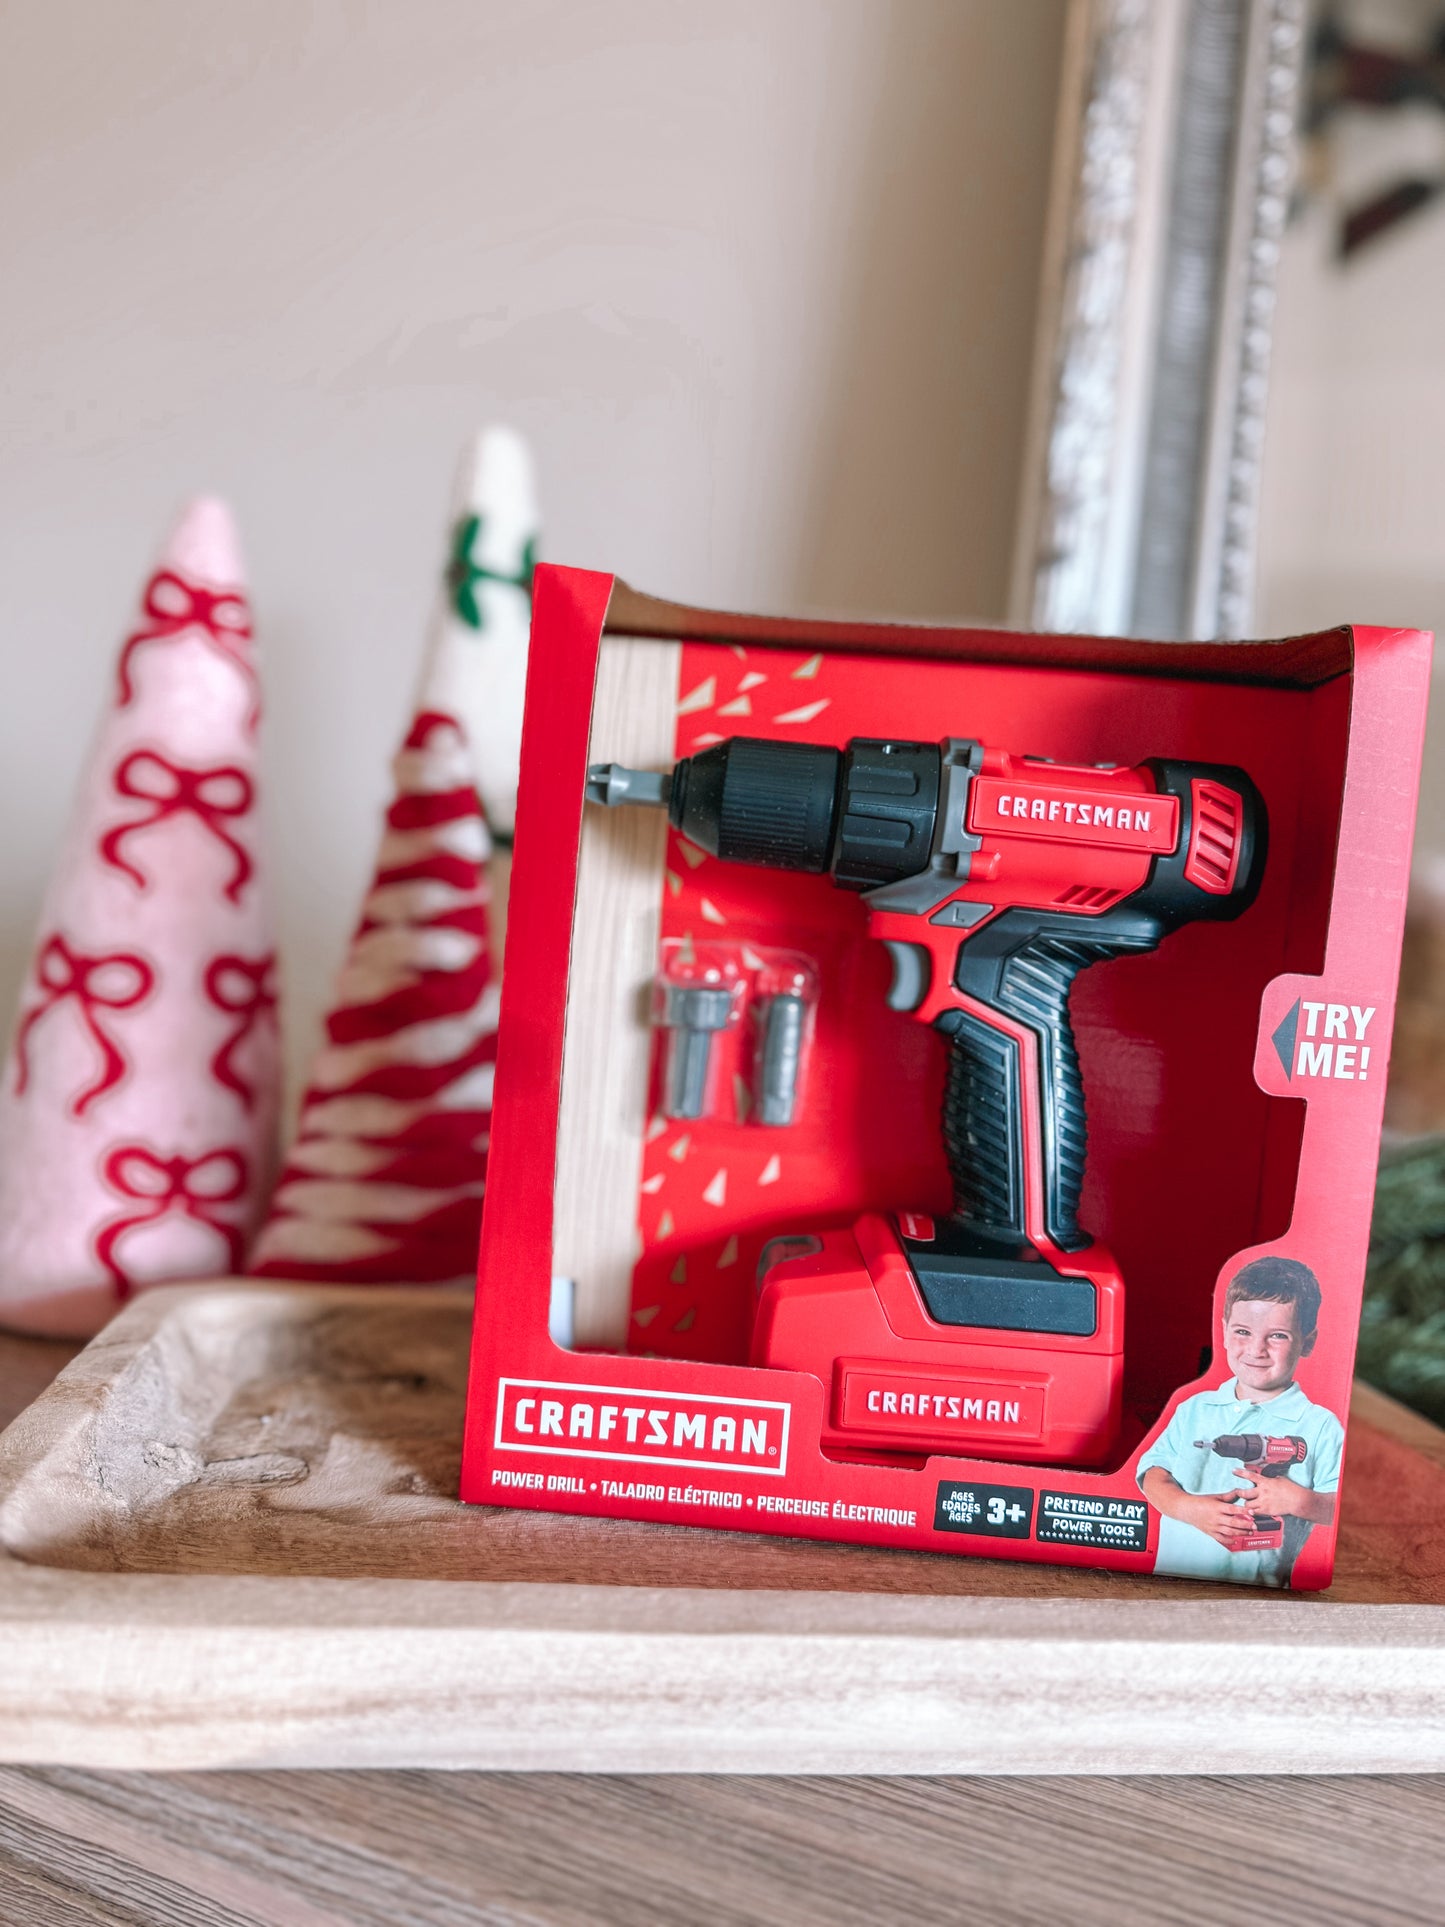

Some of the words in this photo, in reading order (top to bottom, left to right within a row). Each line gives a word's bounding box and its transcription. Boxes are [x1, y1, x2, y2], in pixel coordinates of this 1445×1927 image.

[997, 794, 1150, 832] CRAFTSMAN
[1302, 1001, 1376, 1040] TRY
[1296, 1041, 1371, 1081] ME!
[867, 1390, 1020, 1424] CRAFTSMAN
[491, 1469, 544, 1489] POWER
[547, 1474, 586, 1494] DRILL
[601, 1480, 665, 1501] TALADRO
[667, 1484, 742, 1508] ELÉCTRICO
[757, 1495, 830, 1518] PERCEUSE
[832, 1500, 917, 1527] ÉLECTRIQUE
[941, 1500, 981, 1514] EDADES
[950, 1491, 975, 1502] AGES
[986, 1497, 1026, 1525] 3+
[1044, 1495, 1104, 1515] PRETEND
[1108, 1503, 1145, 1519] PLAY
[1052, 1518, 1093, 1533] POWER
[1099, 1523, 1135, 1537] TOOLS
